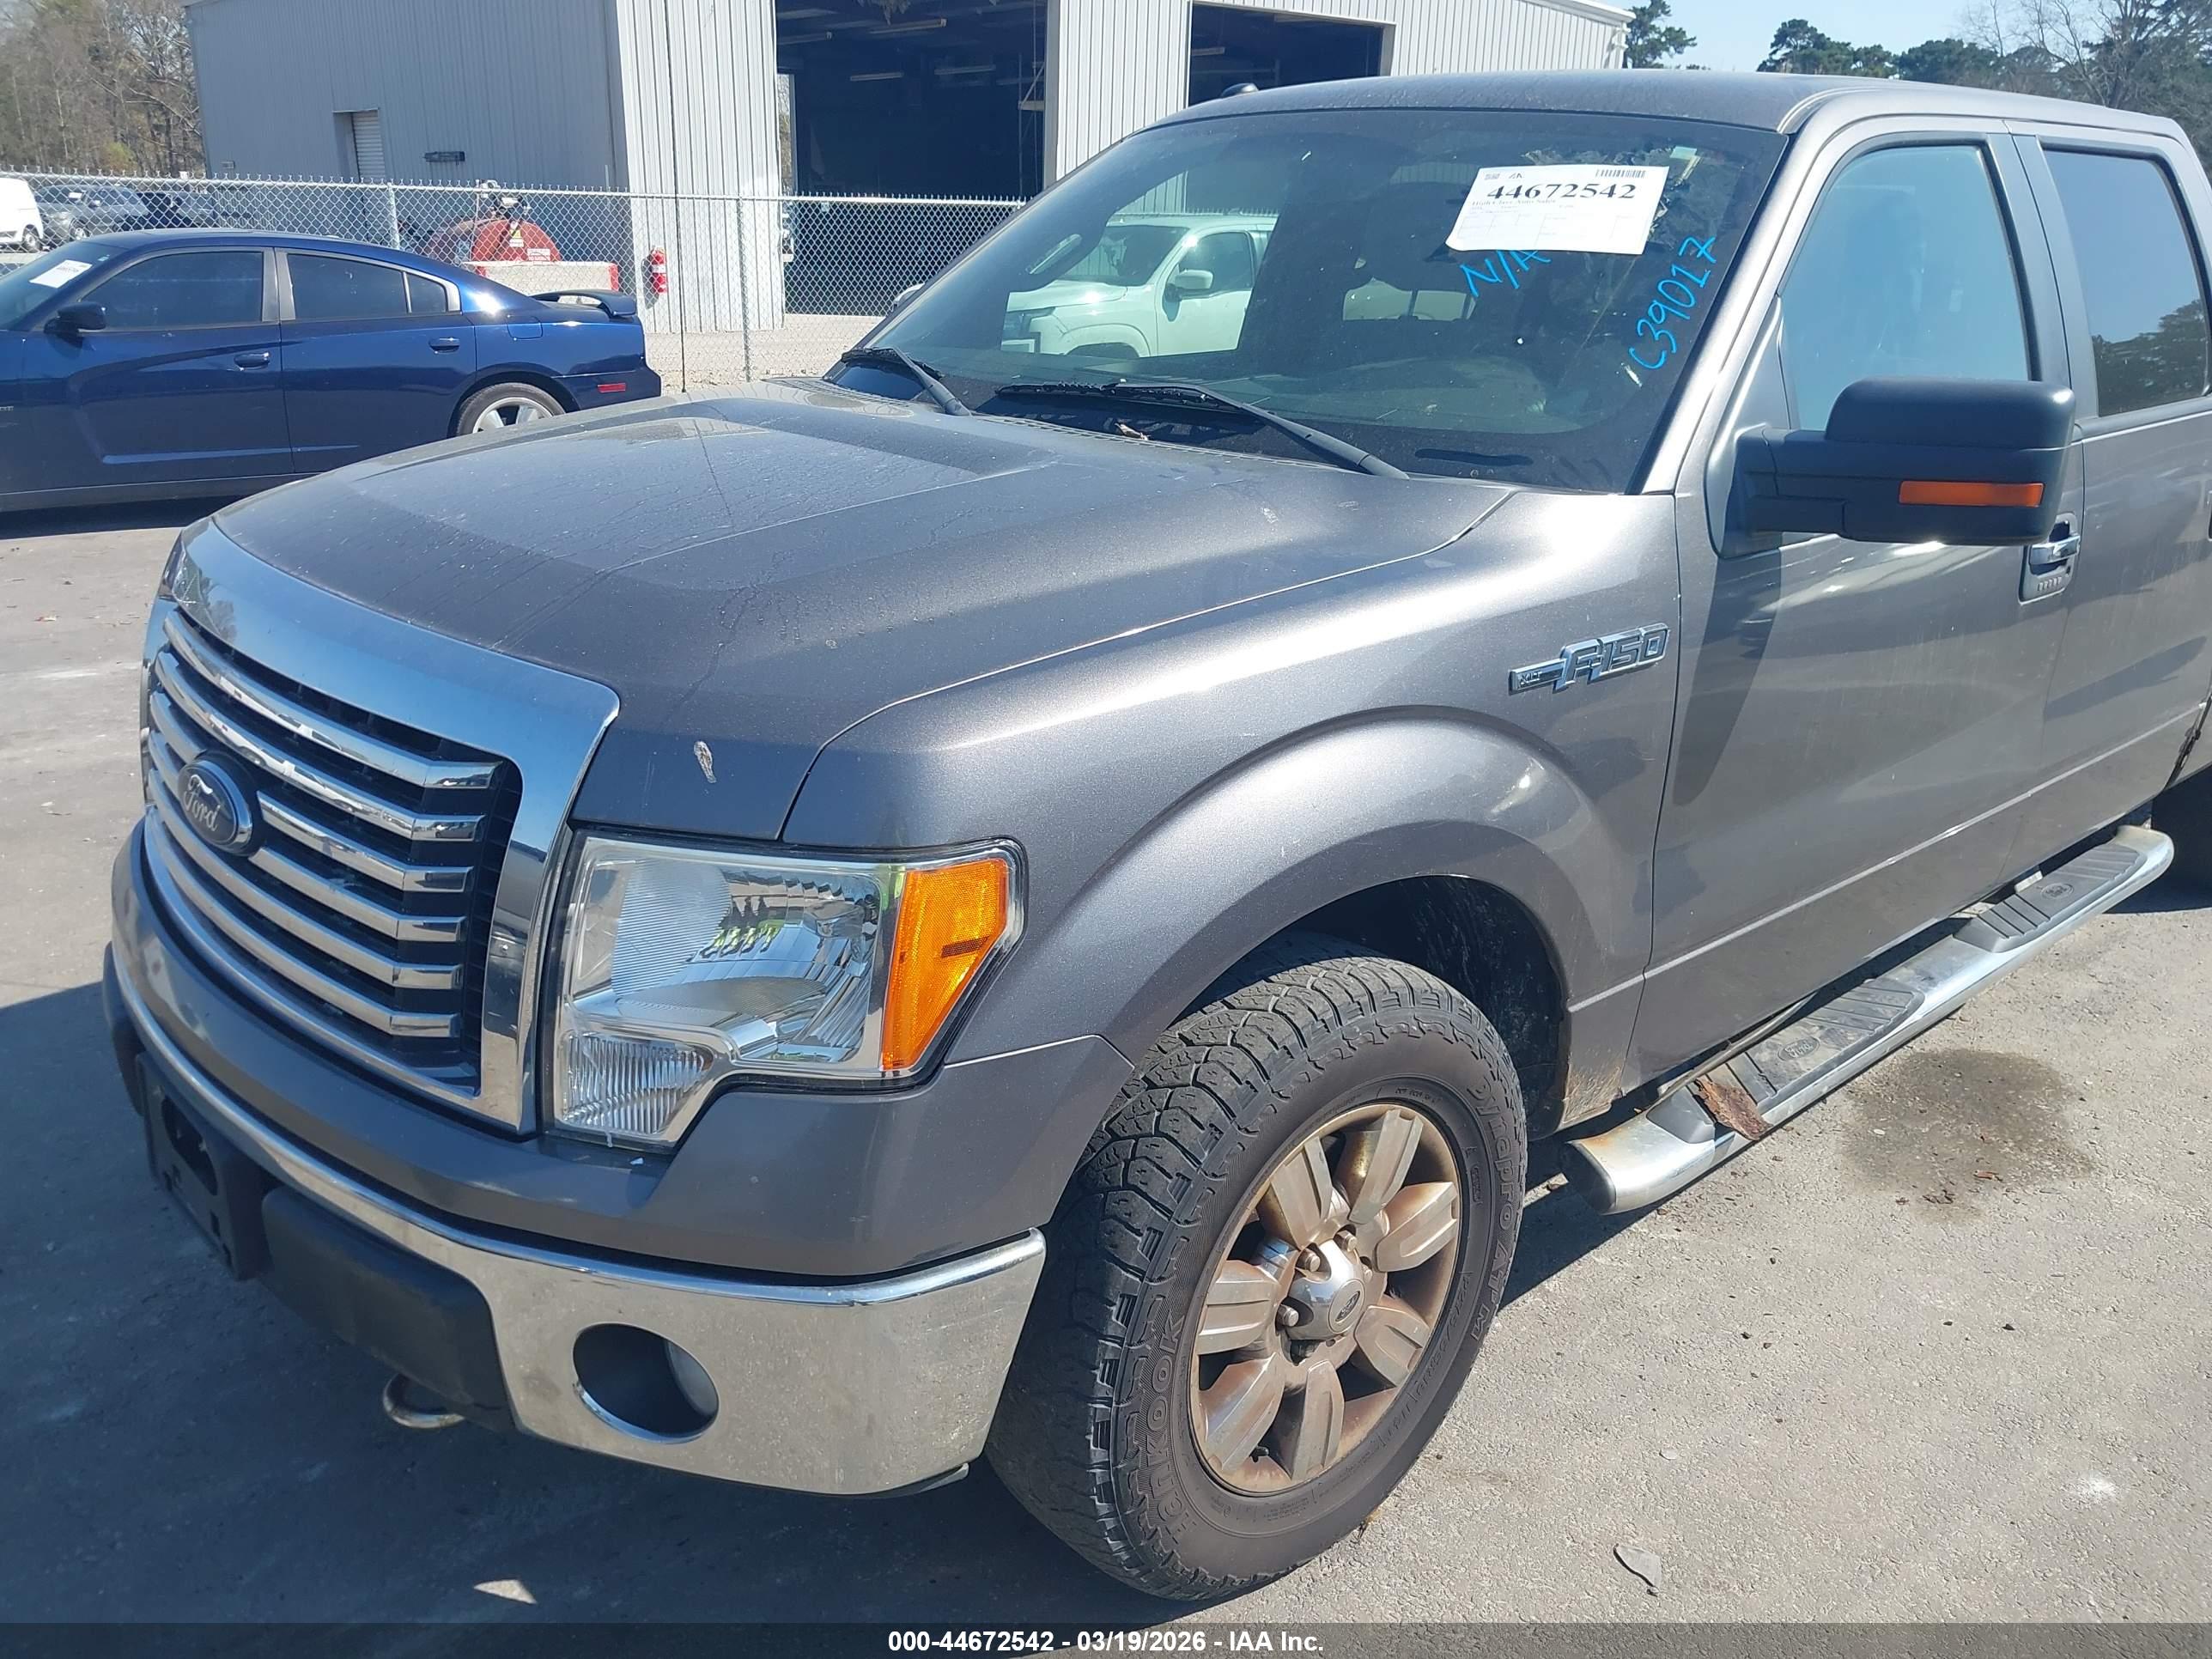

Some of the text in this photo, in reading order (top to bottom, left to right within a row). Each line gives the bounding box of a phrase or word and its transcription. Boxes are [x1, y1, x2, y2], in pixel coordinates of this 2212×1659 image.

[1486, 183, 1637, 199] 44672542
[1461, 250, 1551, 297] N/A
[1629, 236, 1717, 369] C39017
[184, 774, 222, 832] Ford
[1468, 1077, 1516, 1231] Dynapro
